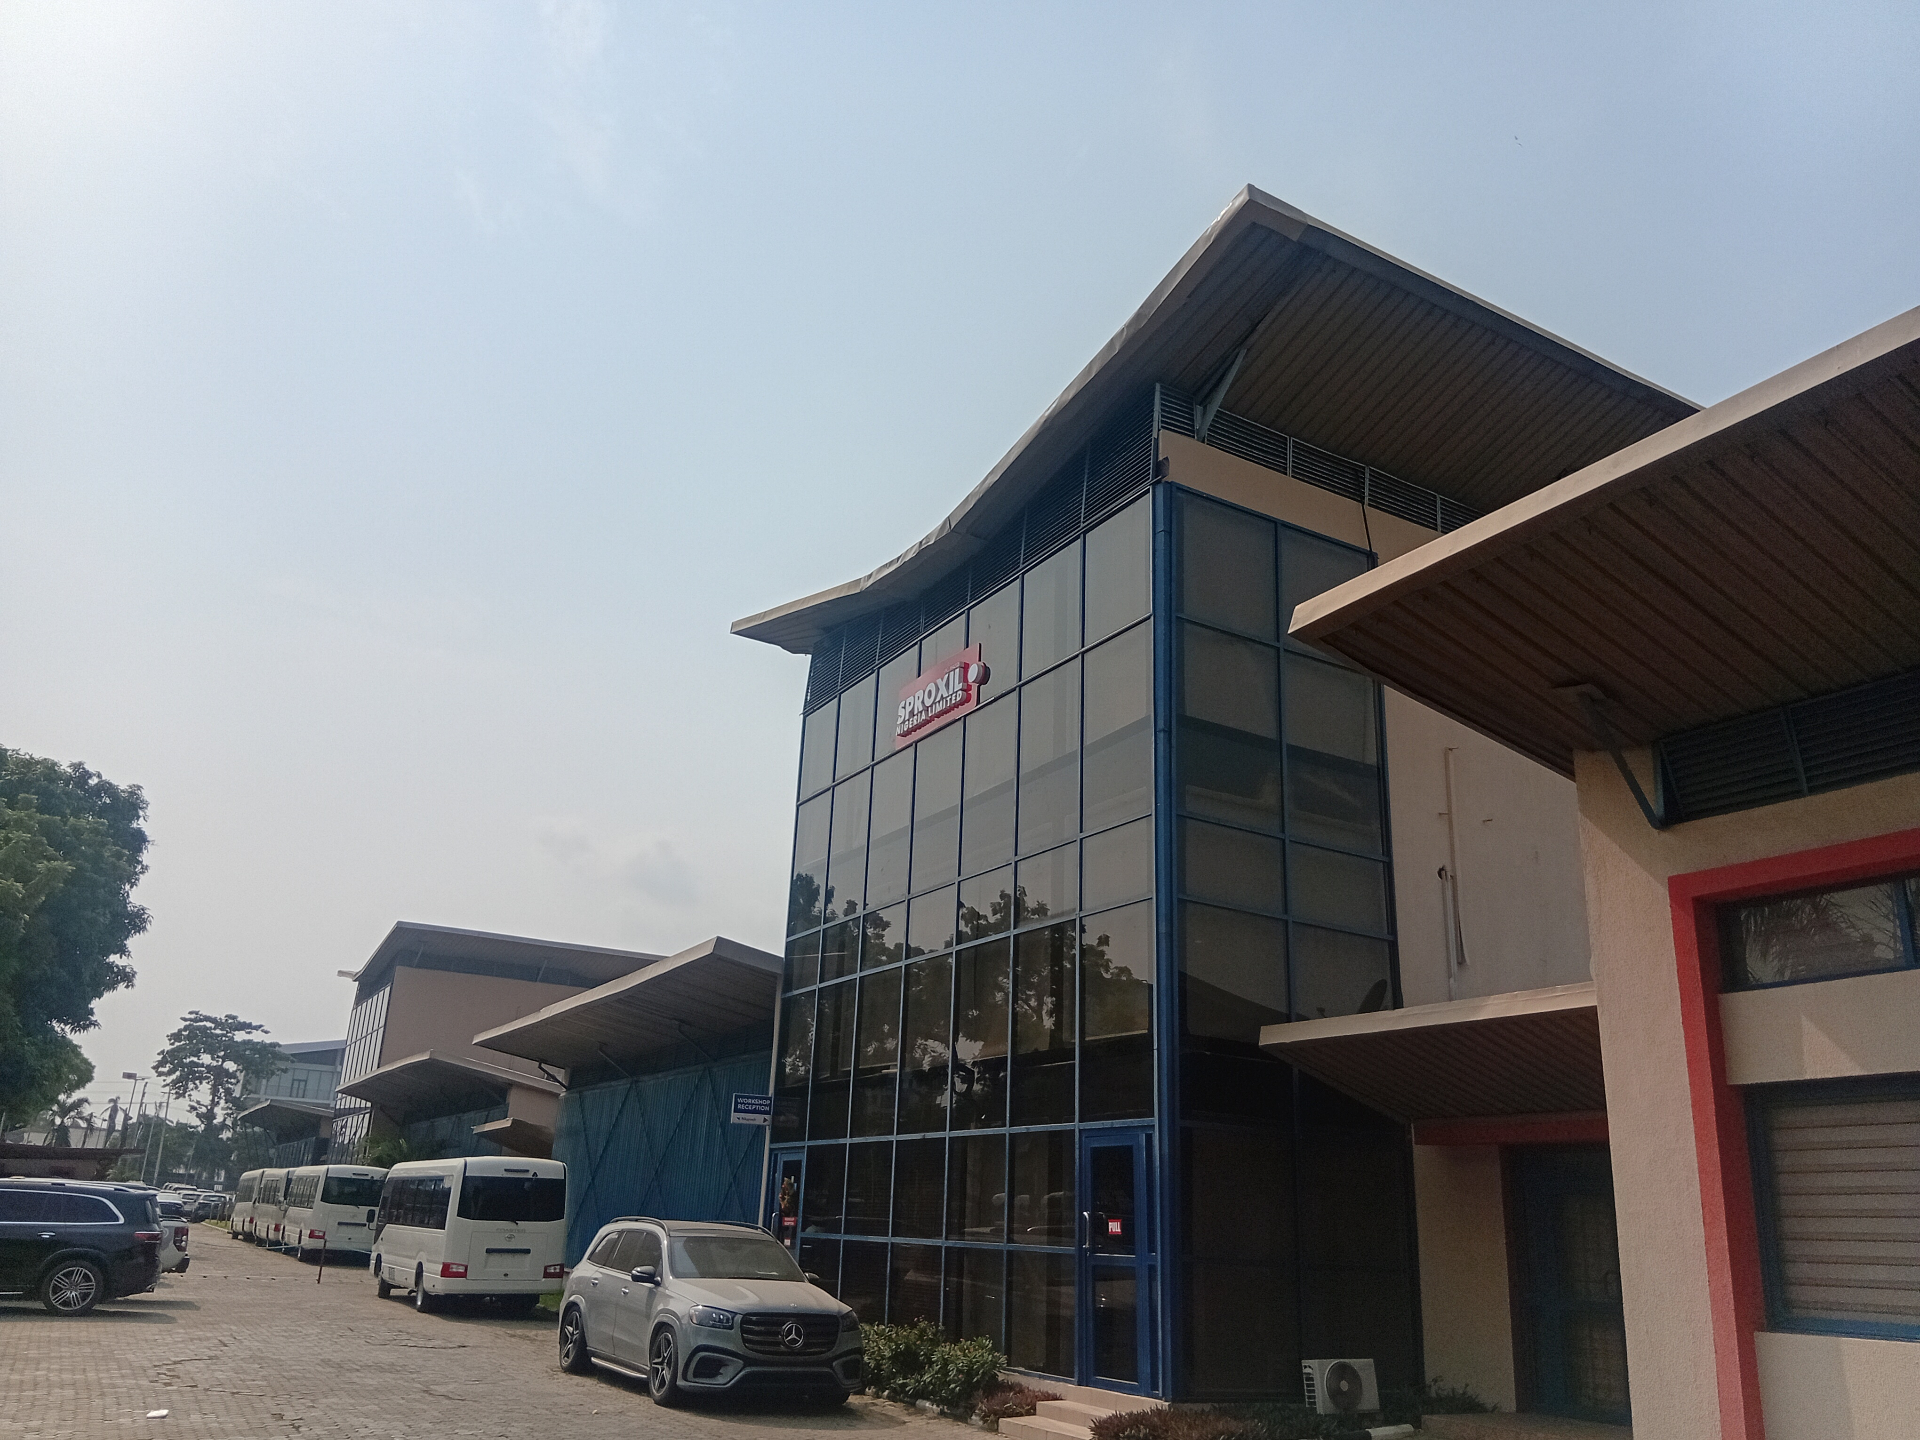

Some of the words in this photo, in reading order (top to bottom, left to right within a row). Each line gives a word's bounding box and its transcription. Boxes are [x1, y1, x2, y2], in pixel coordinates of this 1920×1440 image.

[897, 667, 962, 724] SPROXIL
[896, 710, 926, 735] NIGERIA
[928, 690, 962, 717] LIMITED
[737, 1097, 771, 1105] WORKSHOP
[1108, 1222, 1122, 1232] PULL
